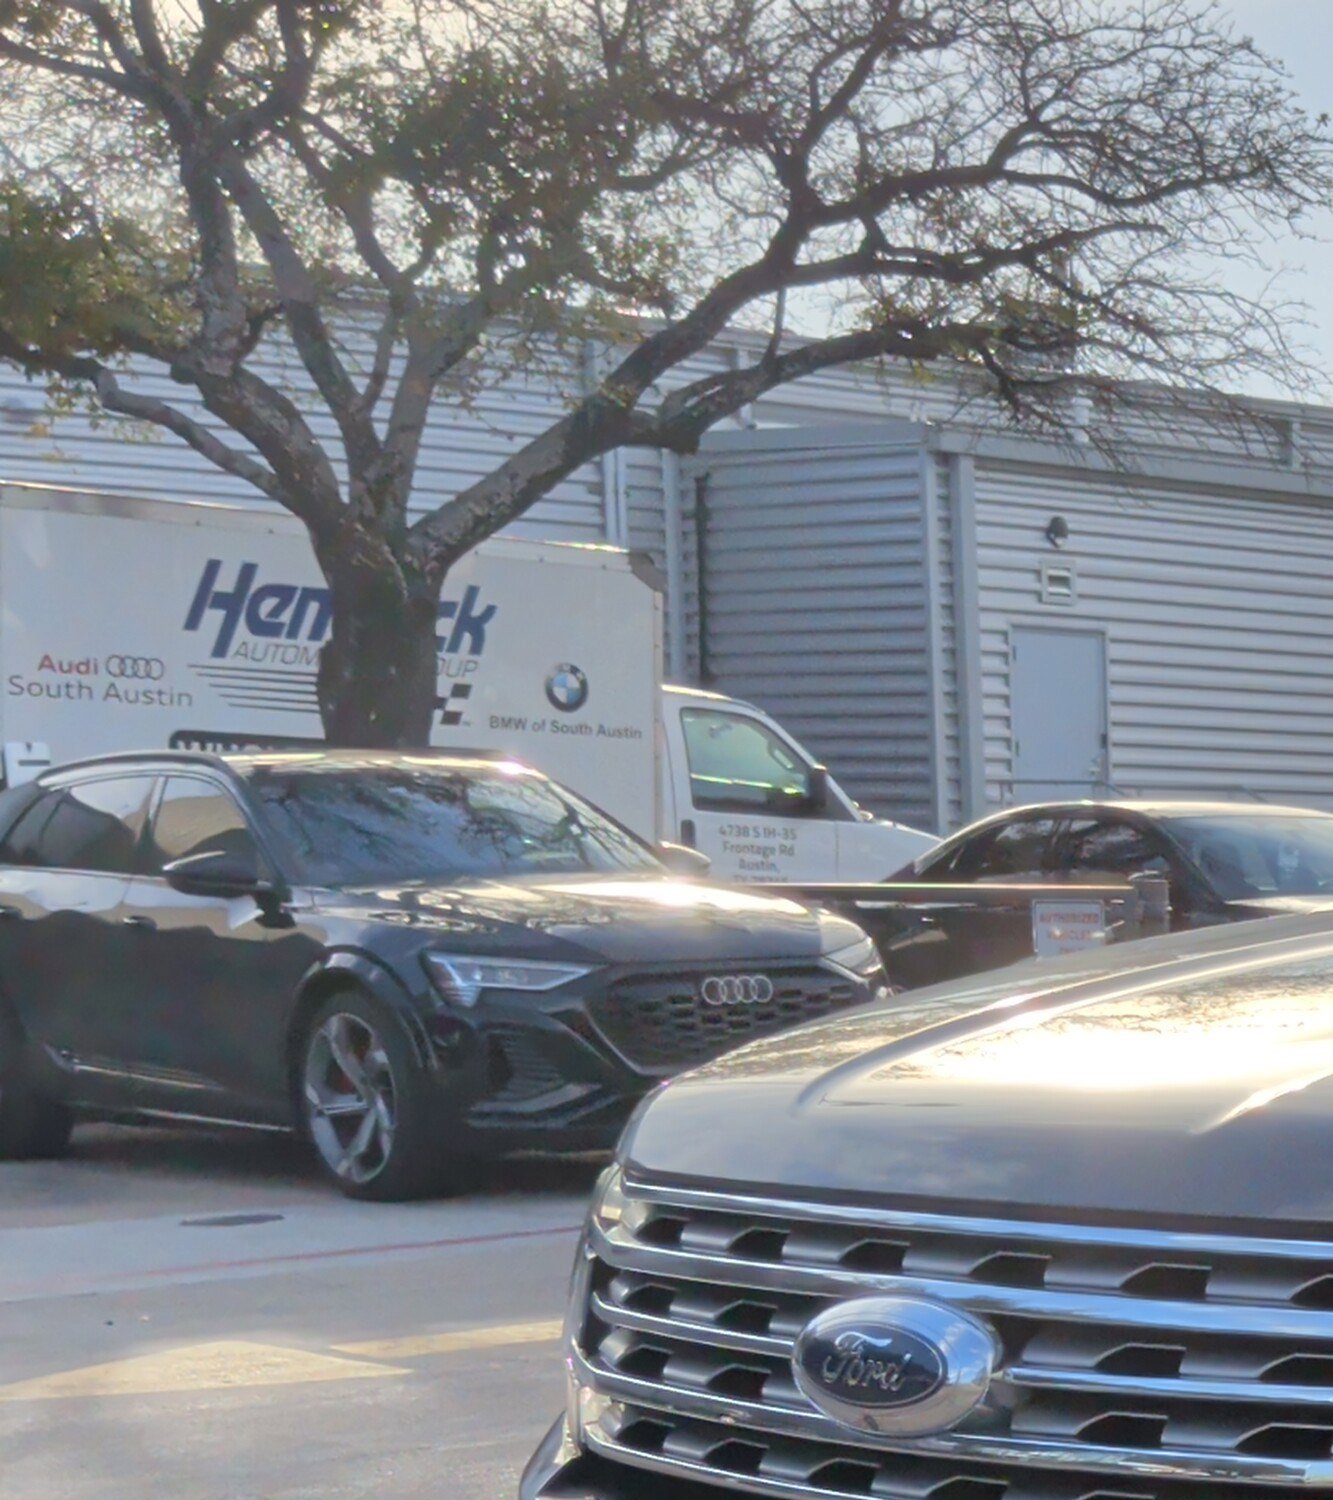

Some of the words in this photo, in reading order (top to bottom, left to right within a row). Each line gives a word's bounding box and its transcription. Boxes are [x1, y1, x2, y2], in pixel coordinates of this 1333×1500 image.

[37, 654, 99, 676] Audi
[8, 675, 94, 700] South
[103, 682, 193, 707] Austin
[489, 715, 527, 731] BMW
[532, 719, 546, 732] of
[550, 719, 593, 736] South
[596, 723, 643, 740] Austin
[718, 824, 750, 838] 4738
[722, 840, 776, 859] Frontage
[779, 843, 795, 857] Rd
[821, 1331, 912, 1392] Ford
